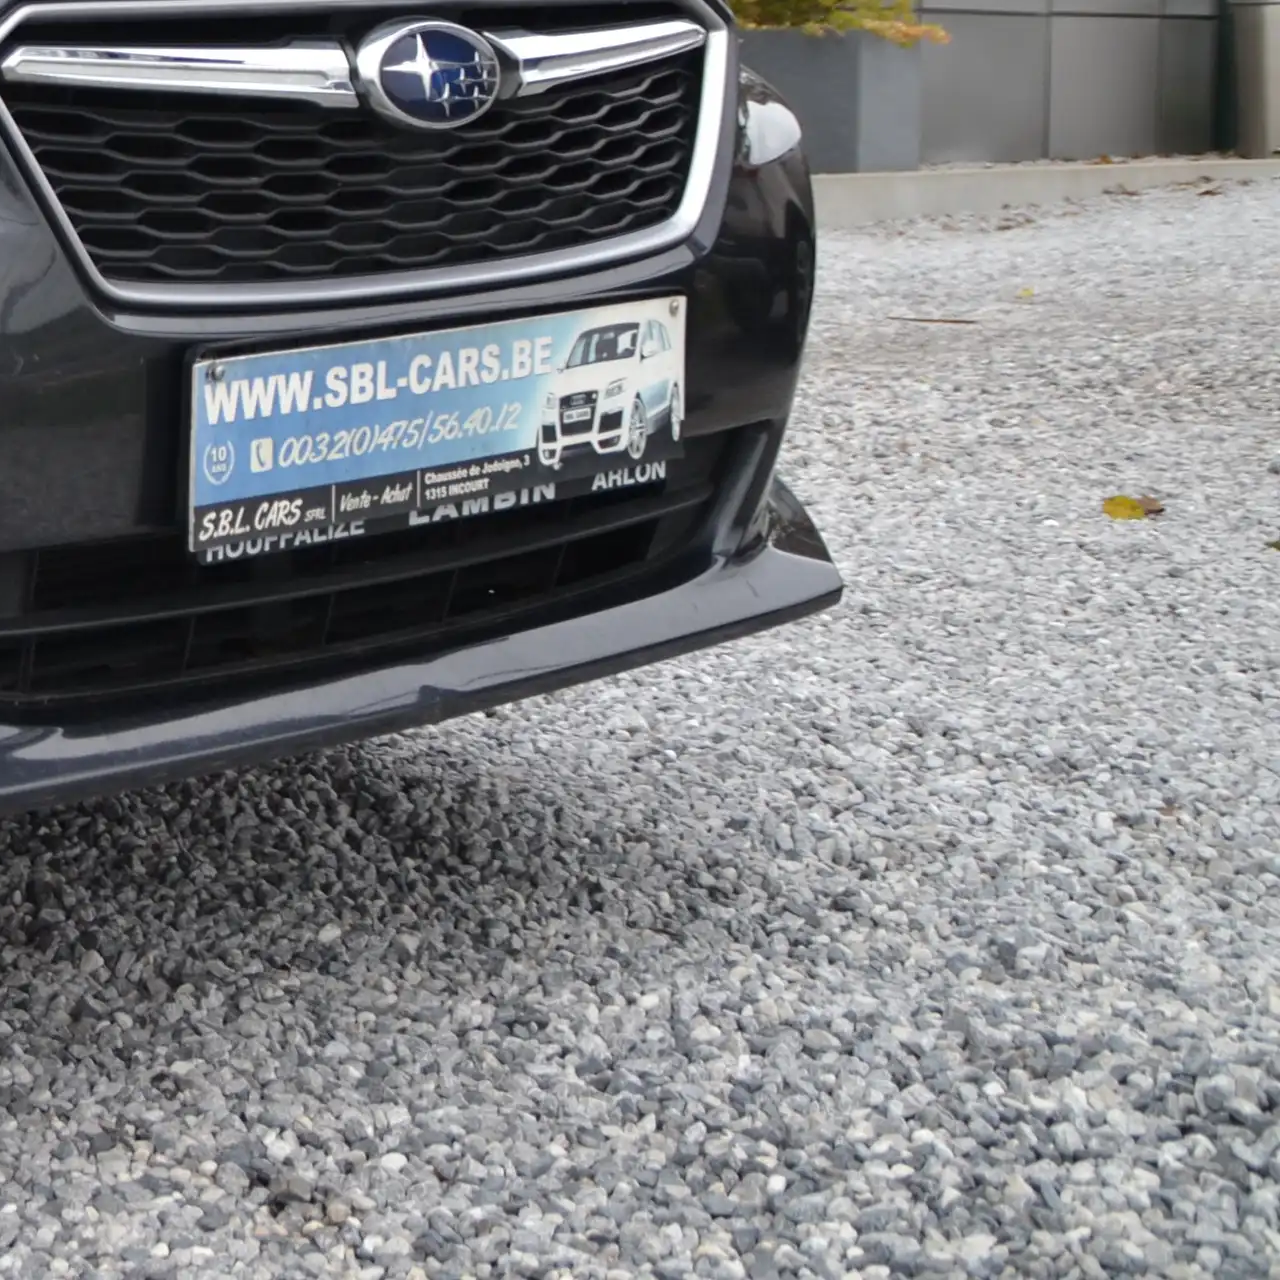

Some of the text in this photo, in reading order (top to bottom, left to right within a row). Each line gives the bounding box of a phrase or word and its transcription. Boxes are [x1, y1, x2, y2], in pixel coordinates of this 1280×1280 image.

[203, 335, 553, 426] WWW.SBL-CARS.BE
[210, 446, 227, 462] 10
[469, 463, 481, 477] de
[339, 491, 371, 512] Vente
[380, 482, 413, 506] Achat
[448, 478, 490, 497] INCOURT
[198, 506, 251, 542] S.B.L.
[254, 498, 304, 532] CARS
